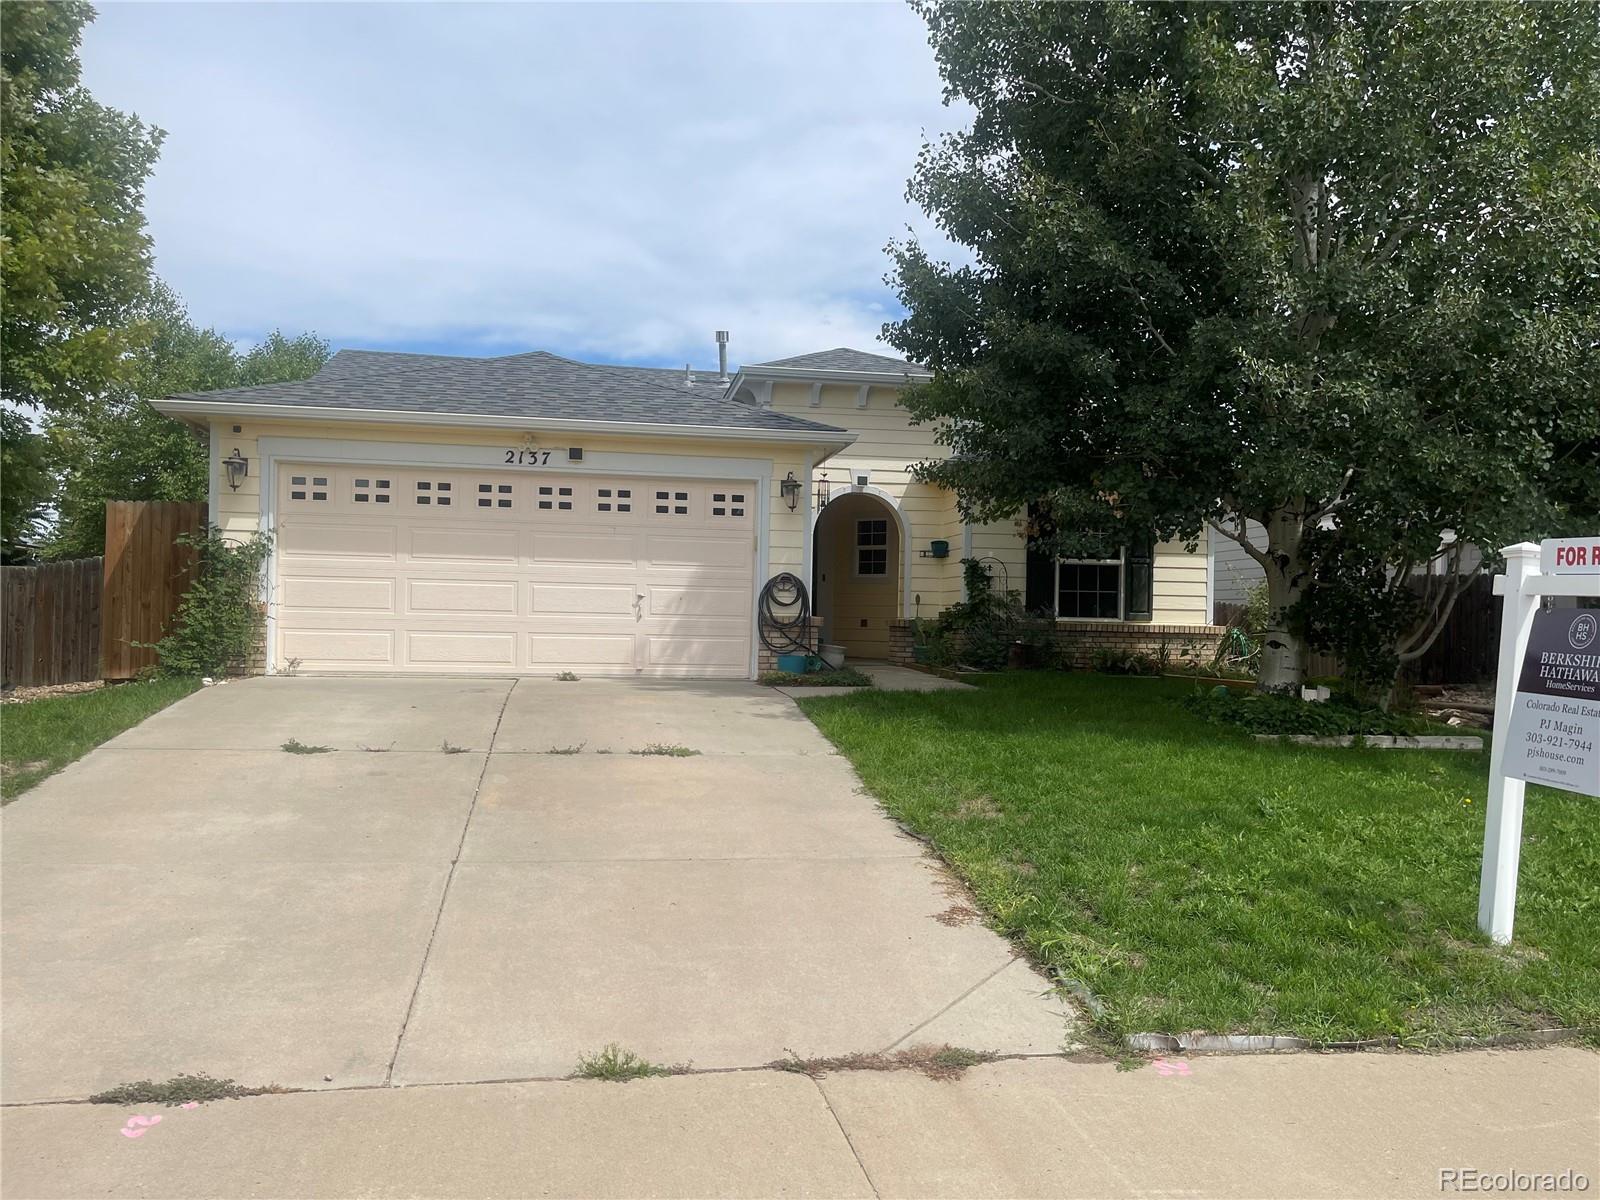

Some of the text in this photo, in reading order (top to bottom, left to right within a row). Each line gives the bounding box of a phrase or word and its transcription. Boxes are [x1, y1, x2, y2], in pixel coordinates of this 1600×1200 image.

[505, 450, 551, 465] 2137
[1556, 546, 1587, 566] FOR
[1577, 623, 1590, 632] BH
[1575, 632, 1588, 641] HS
[1545, 680, 1596, 693] HomeServices
[1526, 699, 1560, 712] Colorado
[1561, 703, 1580, 715] Real
[1539, 719, 1583, 736] PJ Magin
[1525, 731, 1593, 752] 303-921-7944
[1526, 746, 1585, 766] pjshouse.com
